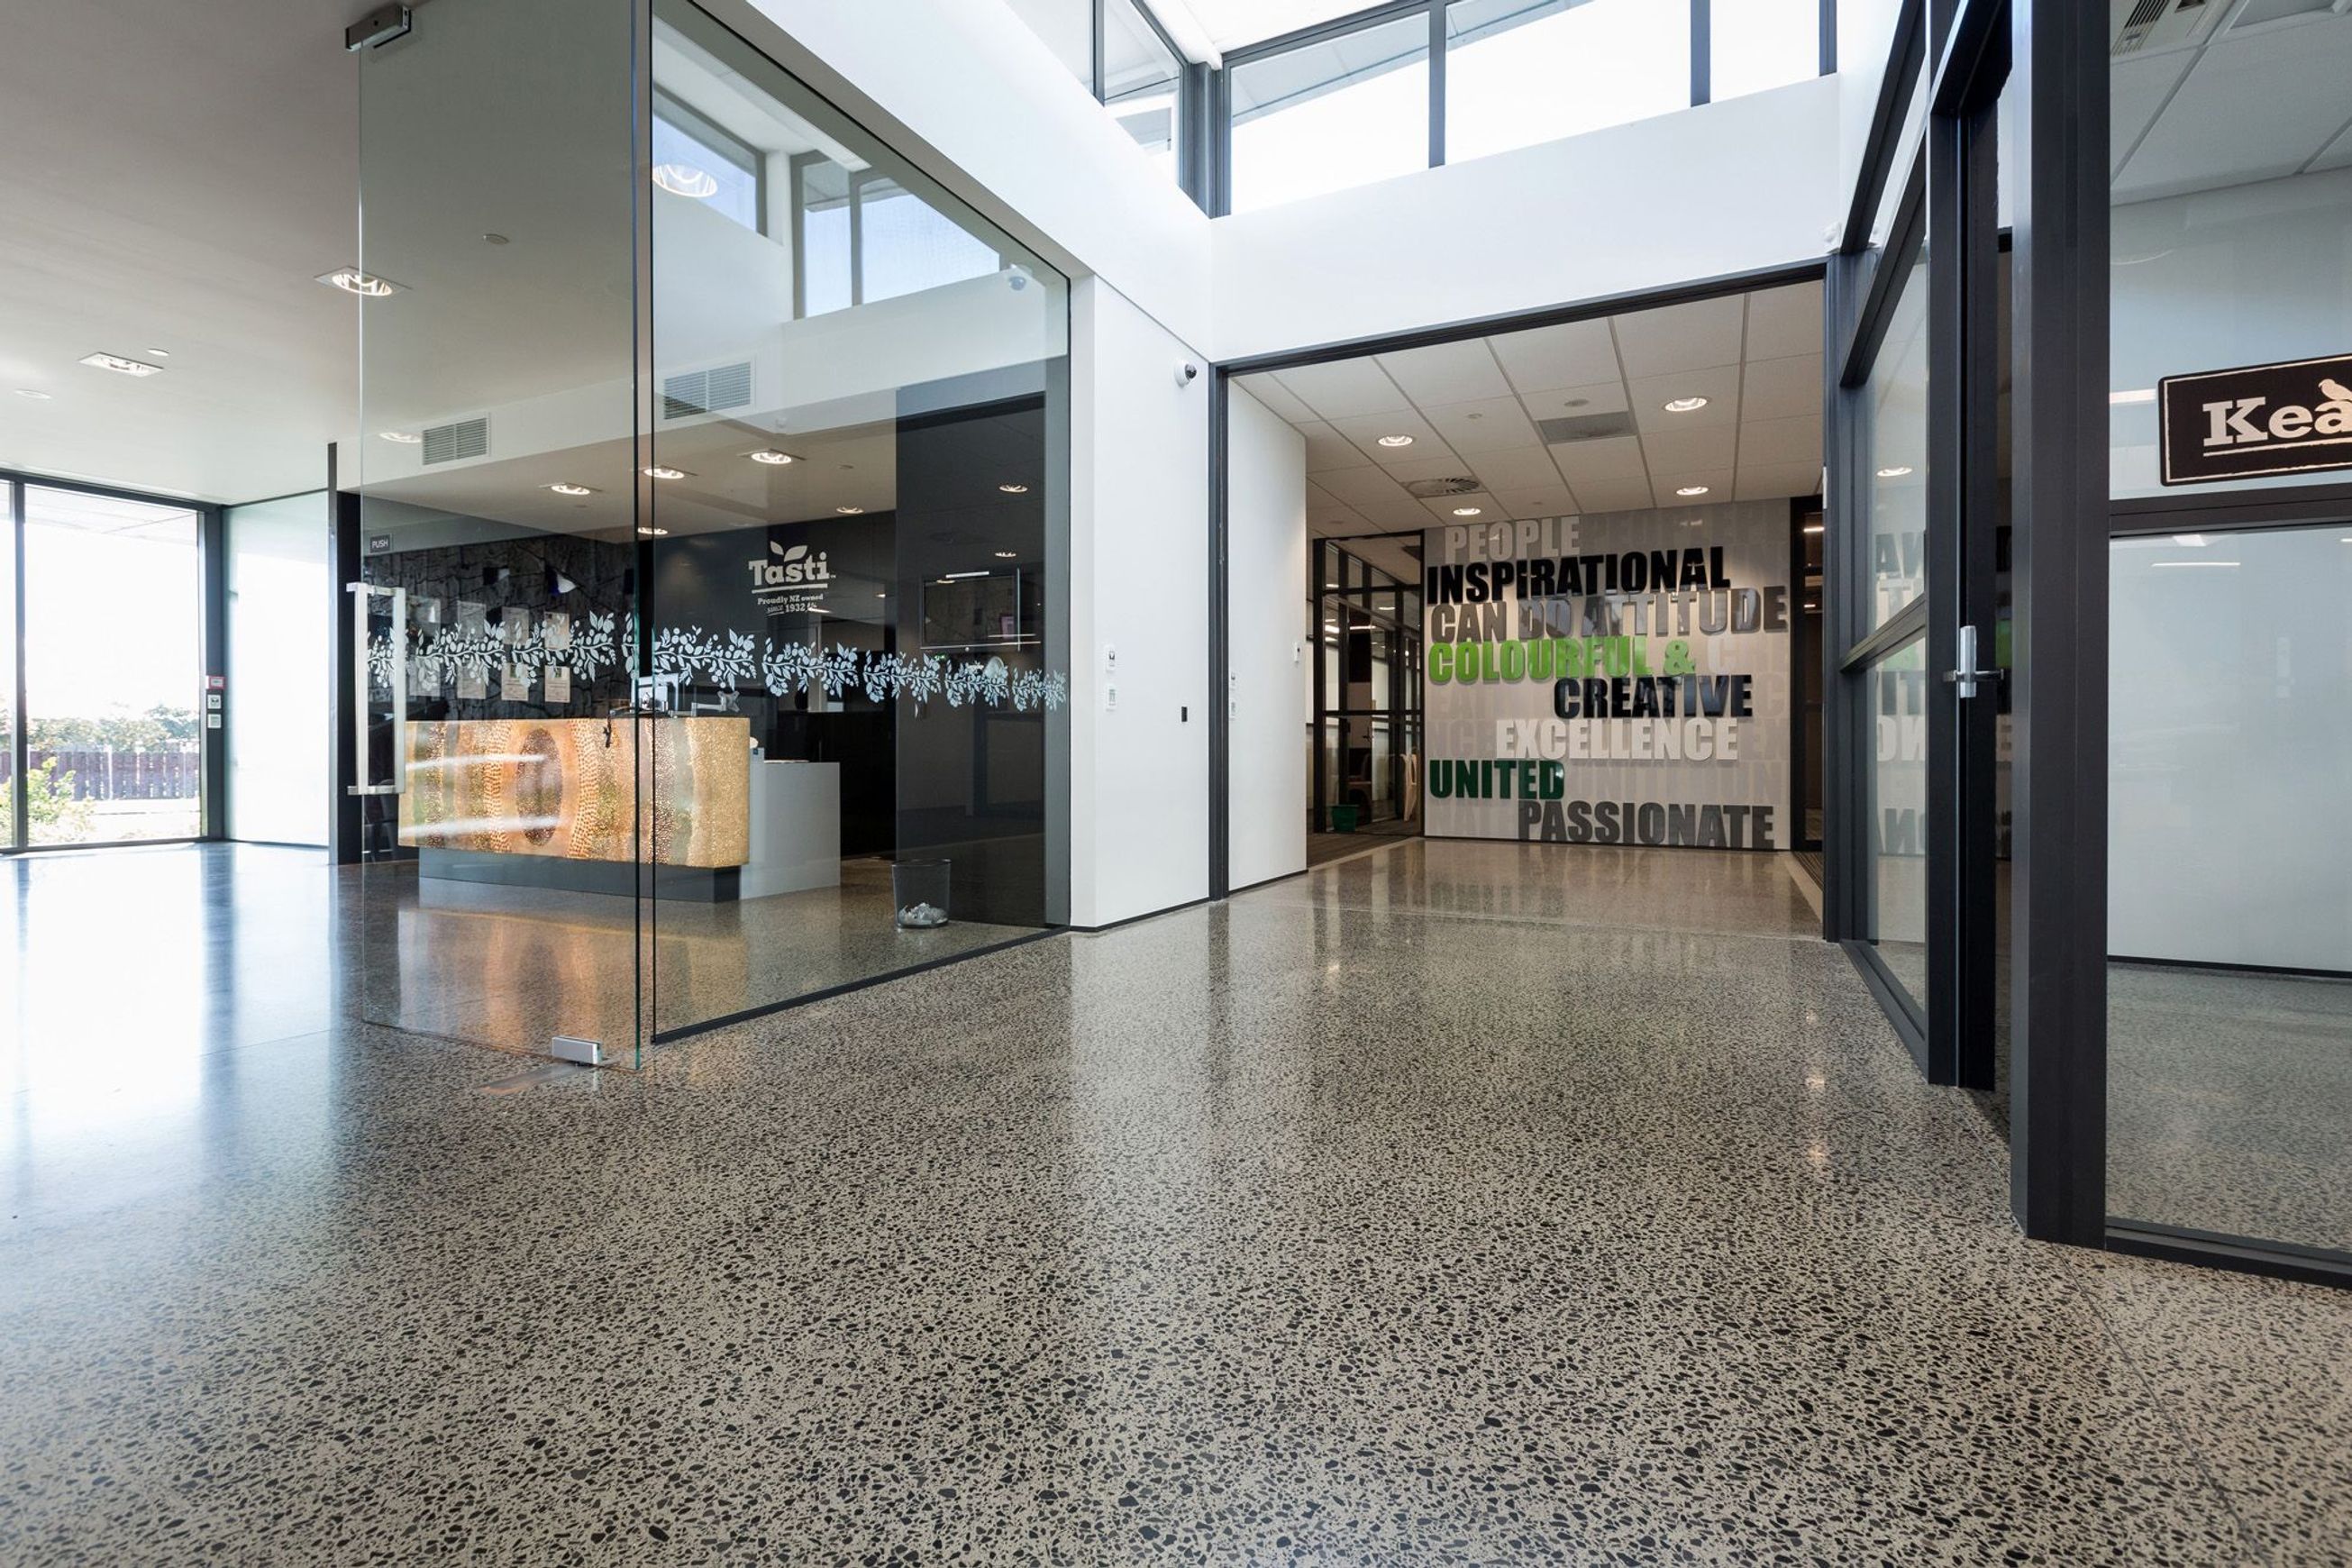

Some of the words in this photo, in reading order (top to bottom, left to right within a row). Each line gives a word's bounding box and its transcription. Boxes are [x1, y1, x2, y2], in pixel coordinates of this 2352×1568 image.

[371, 539, 388, 549] PUSH
[1445, 516, 1580, 564] PEOPLE
[748, 552, 830, 586] Tasti
[1427, 546, 1731, 605] INSPIRATIONAL
[757, 596, 789, 606] Proudly
[789, 595, 800, 603] NZ
[785, 603, 806, 613] 1932
[1431, 601, 1507, 643] CAN
[1518, 597, 1573, 640] DO
[1582, 586, 1789, 637] ATTITUDE
[1428, 635, 1653, 684] COLOURFUL
[1664, 640, 1696, 676] &
[1554, 674, 1753, 719] CREATIVE
[1496, 717, 1738, 761] EXCELLENCE
[1429, 760, 1565, 800] UNITED
[1518, 800, 1775, 849] PASSIONATE
